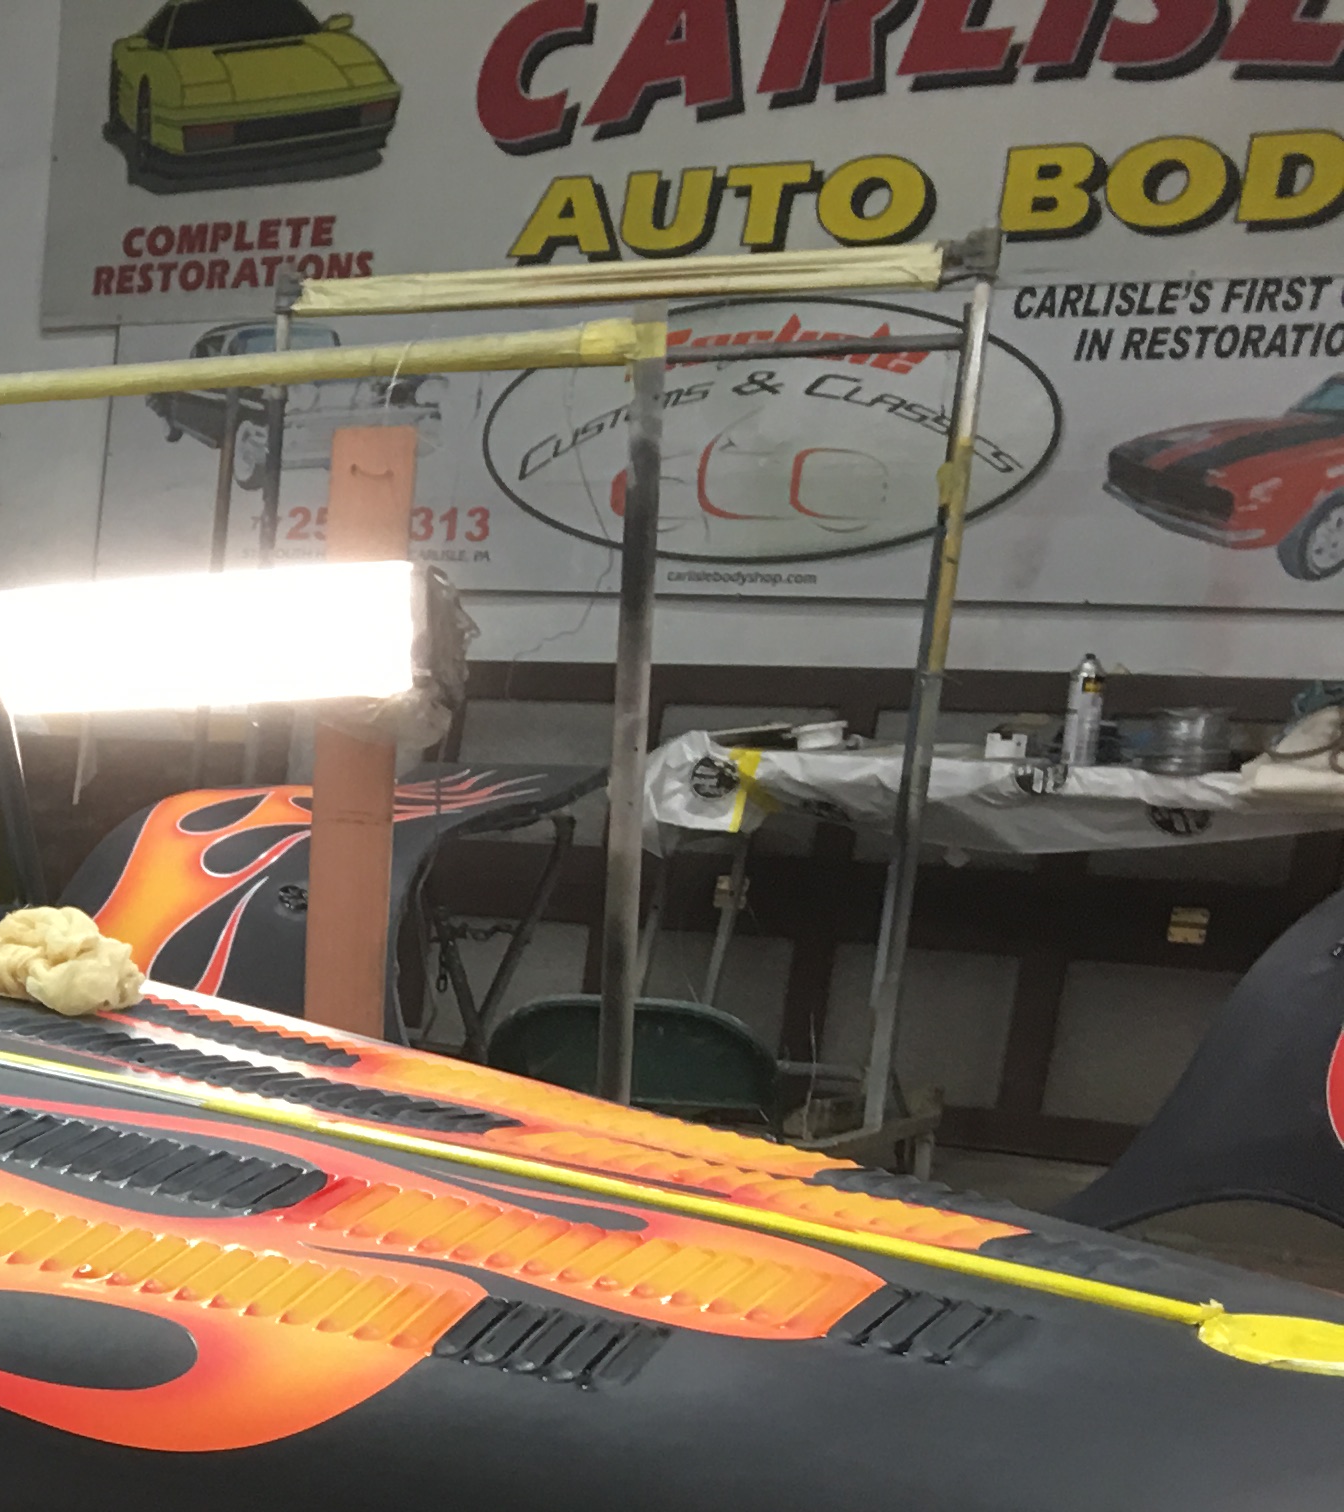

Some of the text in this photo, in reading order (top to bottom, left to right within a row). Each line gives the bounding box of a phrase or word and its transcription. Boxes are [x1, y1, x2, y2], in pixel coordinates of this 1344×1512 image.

[506, 153, 936, 268] AUTO
[122, 215, 337, 258] COMPLETE
[91, 250, 375, 296] RESTORATONS
[1013, 275, 1334, 320] CARLISLE'S FIRST
[1073, 328, 1116, 362] IN
[518, 370, 1025, 481] CUSTMS & CLASSCS
